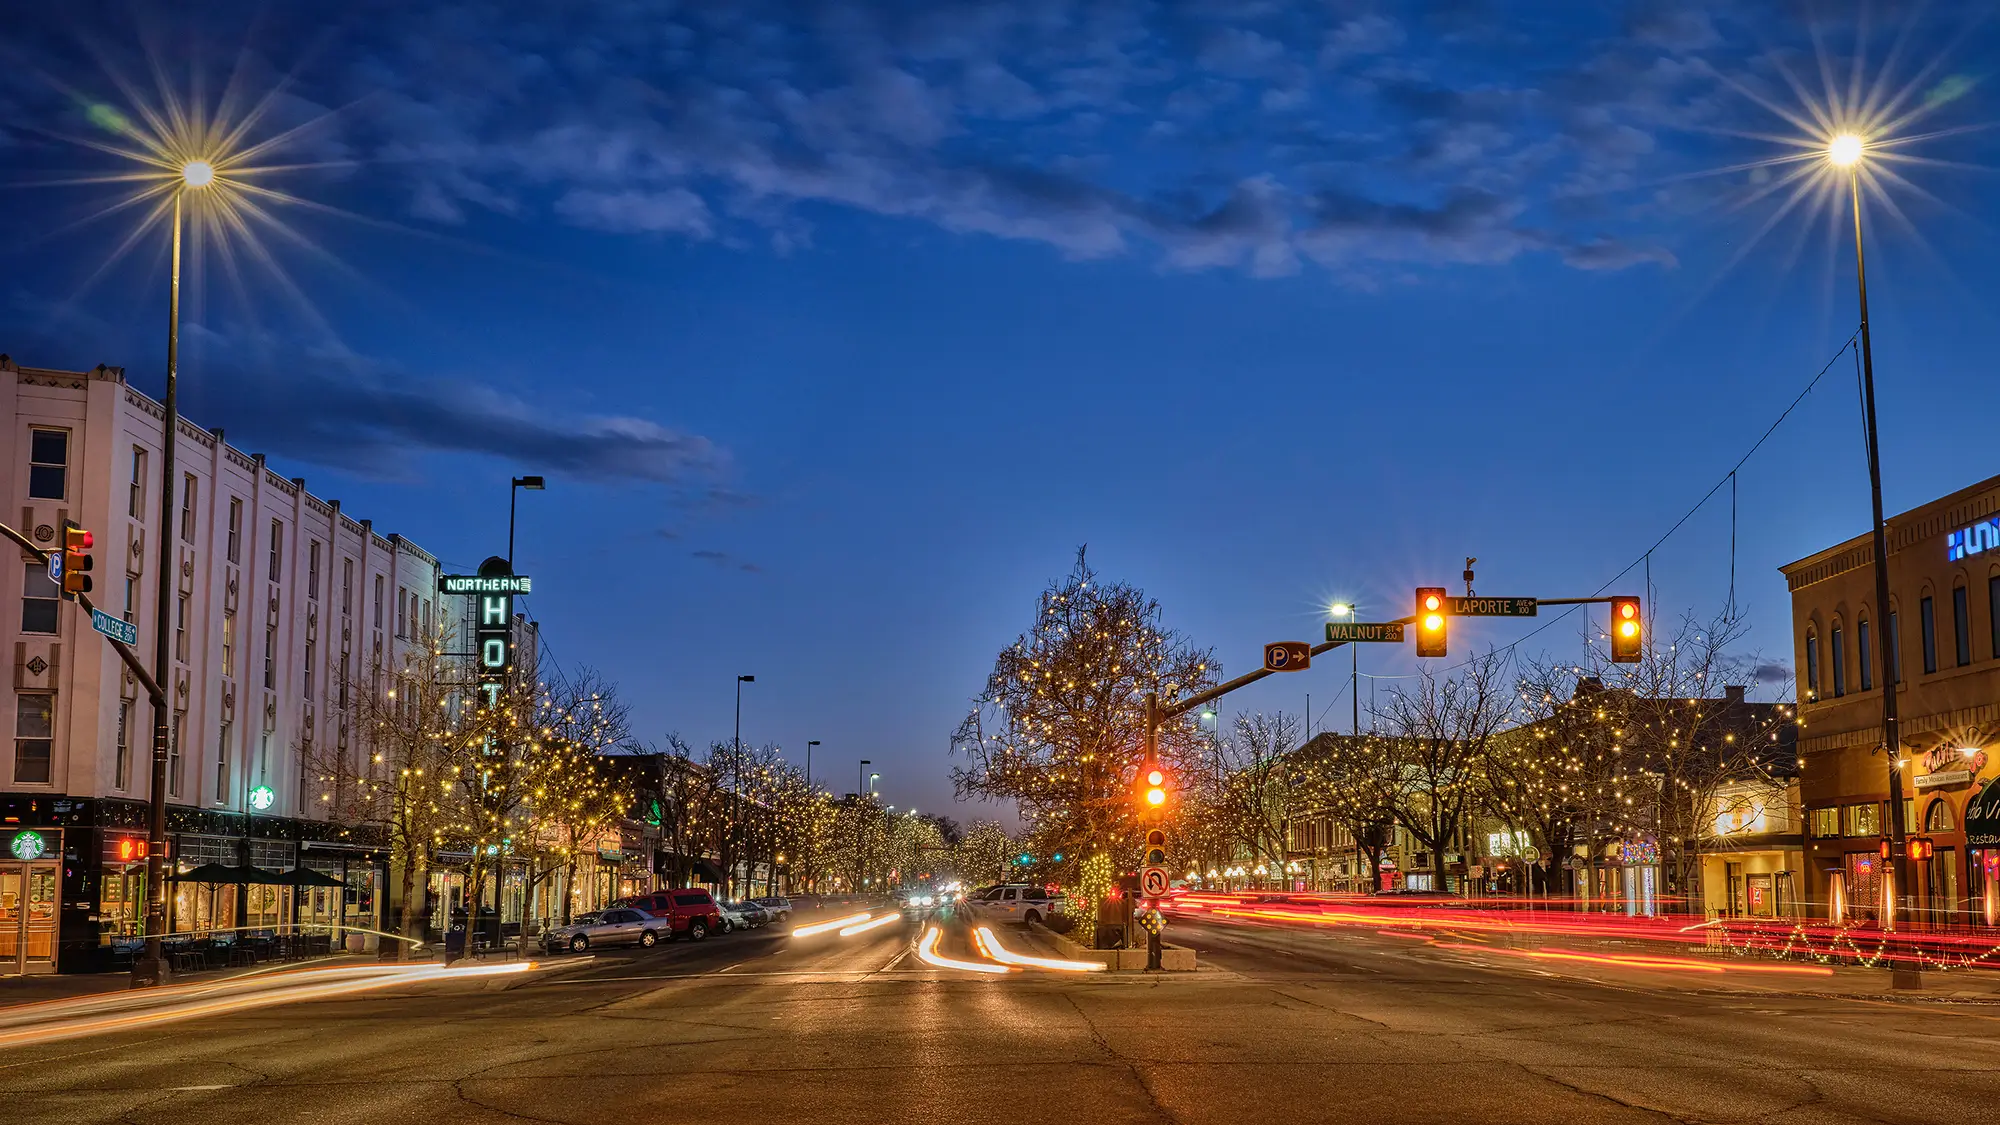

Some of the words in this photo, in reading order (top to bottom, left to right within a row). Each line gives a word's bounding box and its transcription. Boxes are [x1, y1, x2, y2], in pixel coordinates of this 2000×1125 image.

[447, 579, 520, 591] NORTHERN
[1455, 600, 1511, 614] LAPORTE
[97, 614, 123, 638] COLLEGE
[1330, 626, 1382, 639] WALNUT
[1386, 625, 1394, 633] ST
